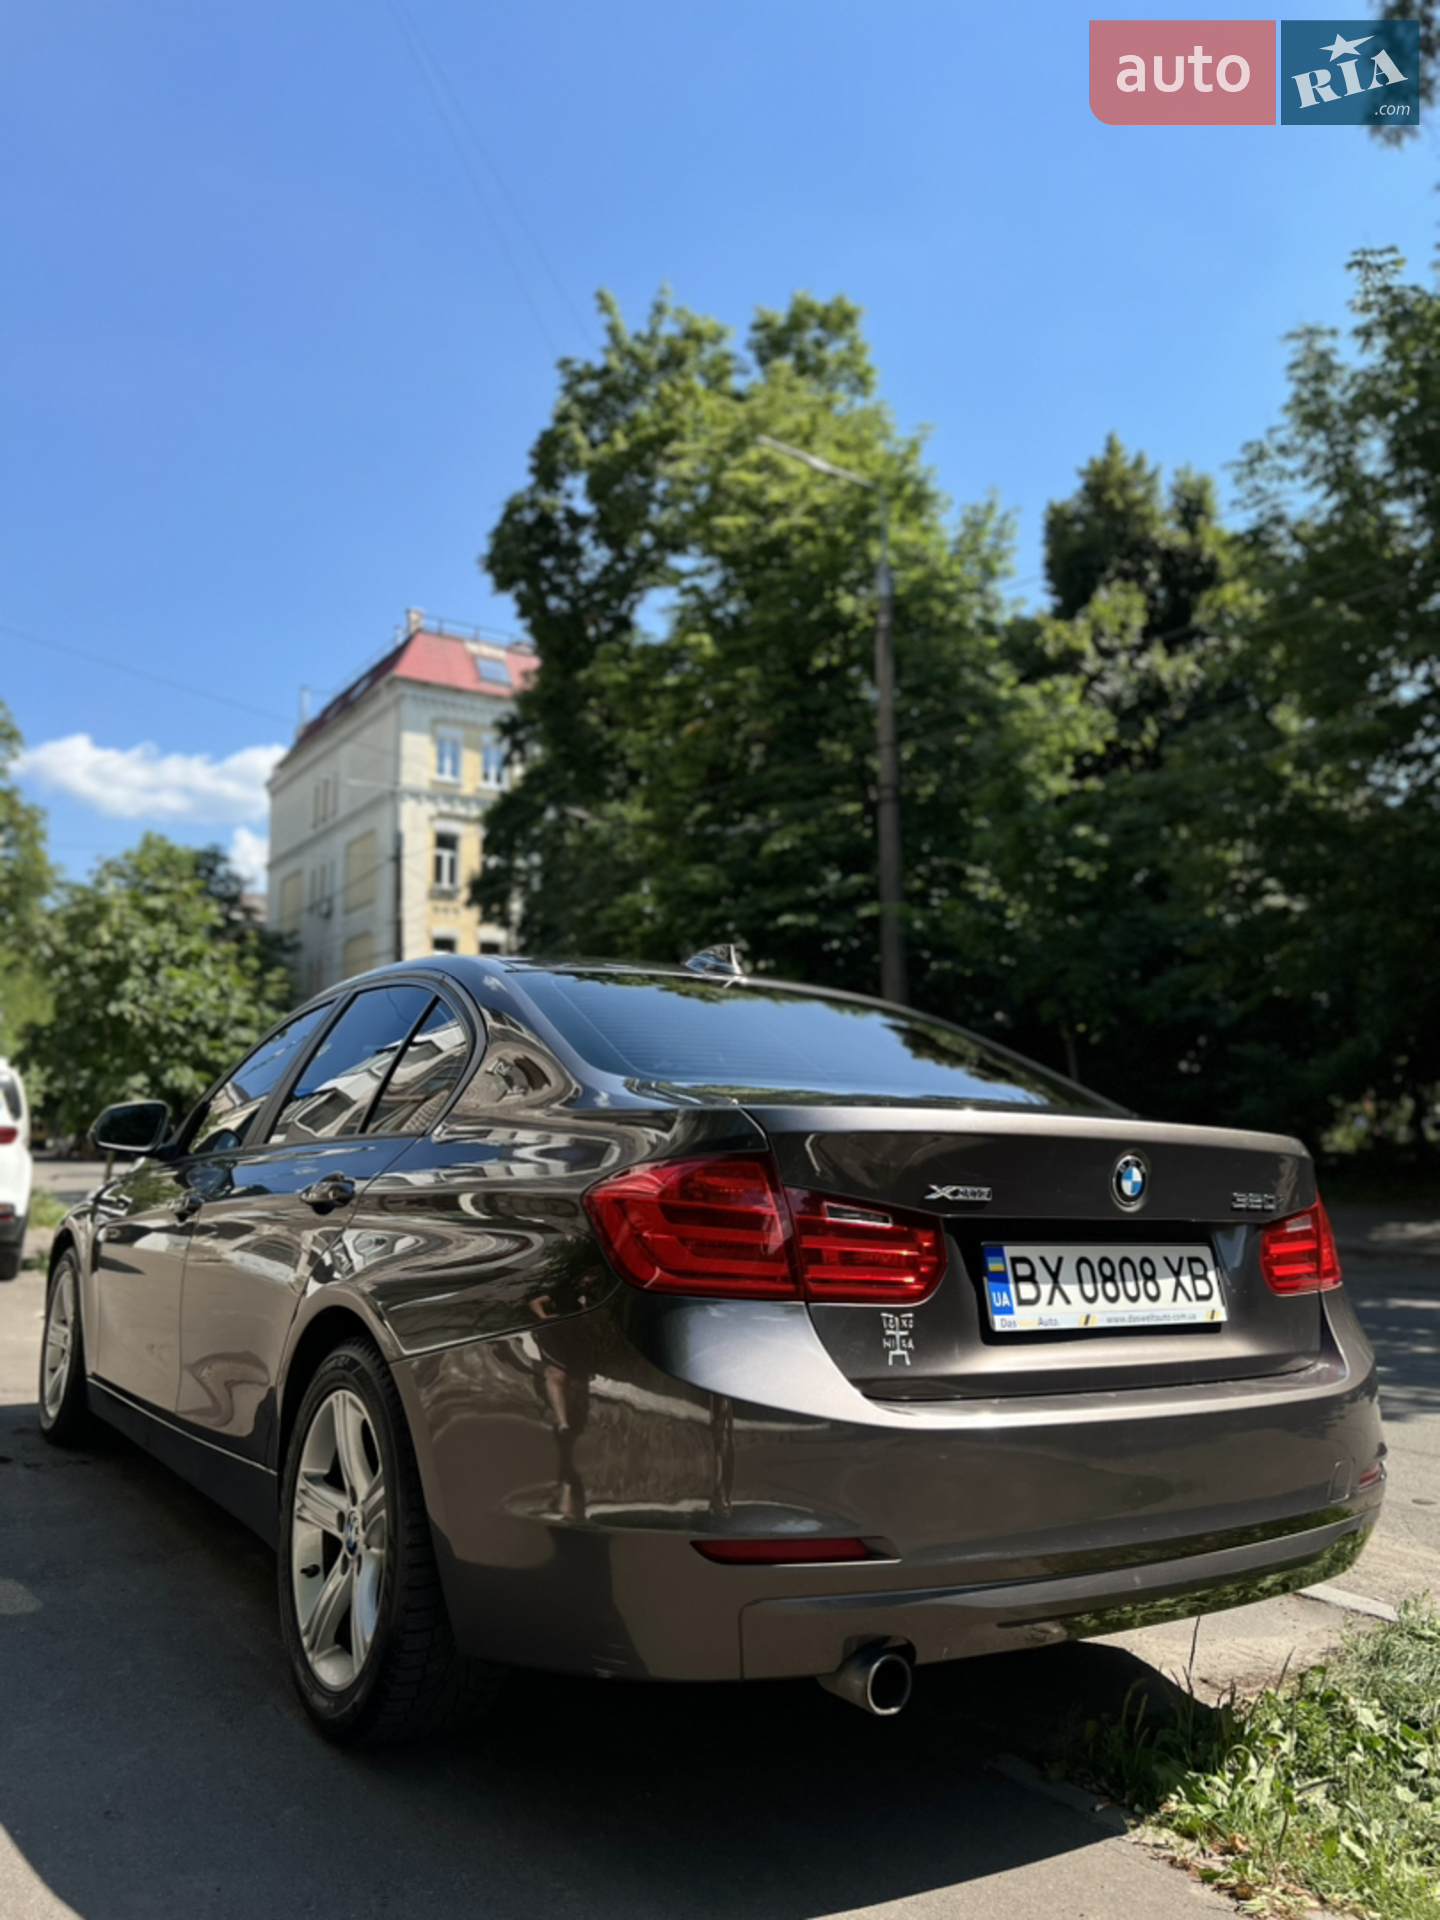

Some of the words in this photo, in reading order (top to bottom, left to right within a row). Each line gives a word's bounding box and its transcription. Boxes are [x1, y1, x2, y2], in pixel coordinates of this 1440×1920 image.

[1009, 1256, 1072, 1306] BX
[1075, 1256, 1161, 1304] 0808
[1162, 1256, 1214, 1303] XB
[992, 1291, 1011, 1307] UA
